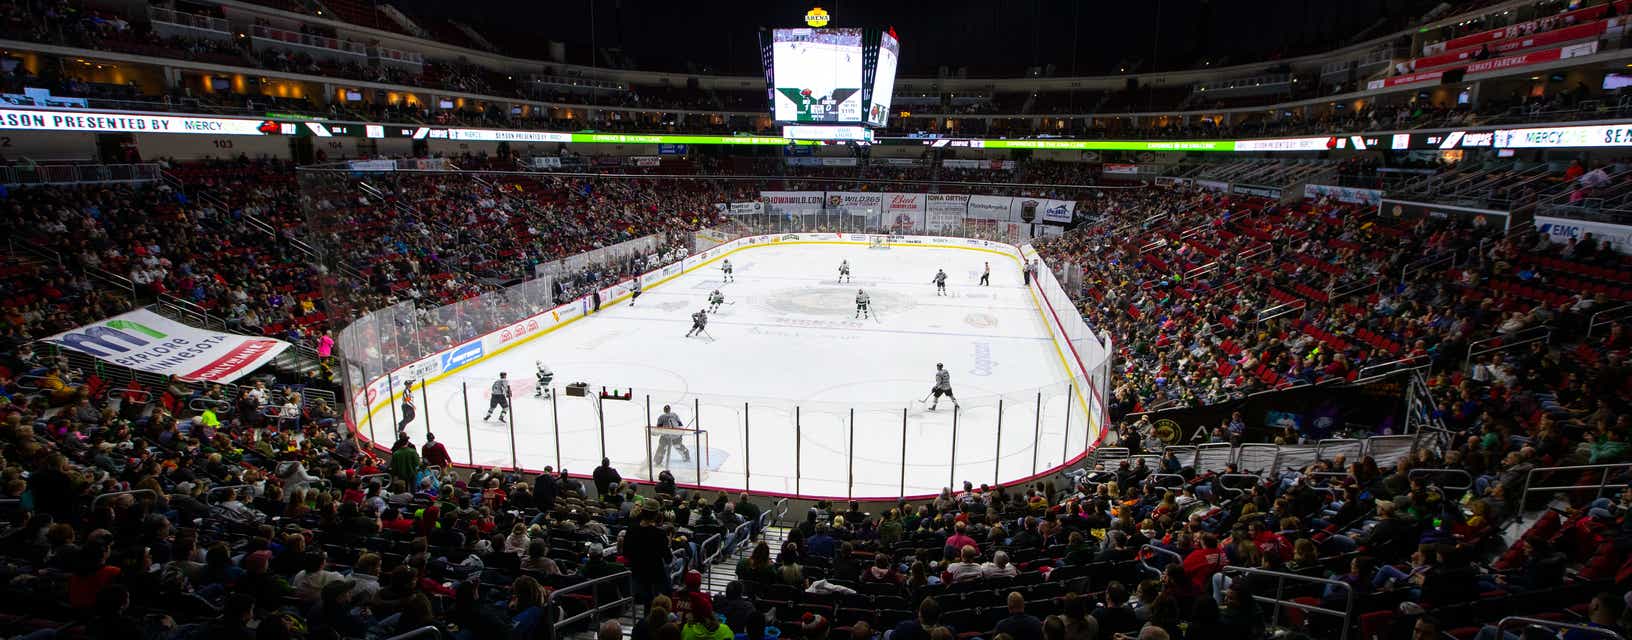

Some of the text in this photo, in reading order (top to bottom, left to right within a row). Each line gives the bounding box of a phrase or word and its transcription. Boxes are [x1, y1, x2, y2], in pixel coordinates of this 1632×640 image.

[1467, 60, 1492, 72] ALWAYS
[53, 115, 146, 129] PRESENTED
[151, 119, 169, 130] BY
[213, 140, 233, 149] 103
[1553, 225, 1579, 237] EMC
